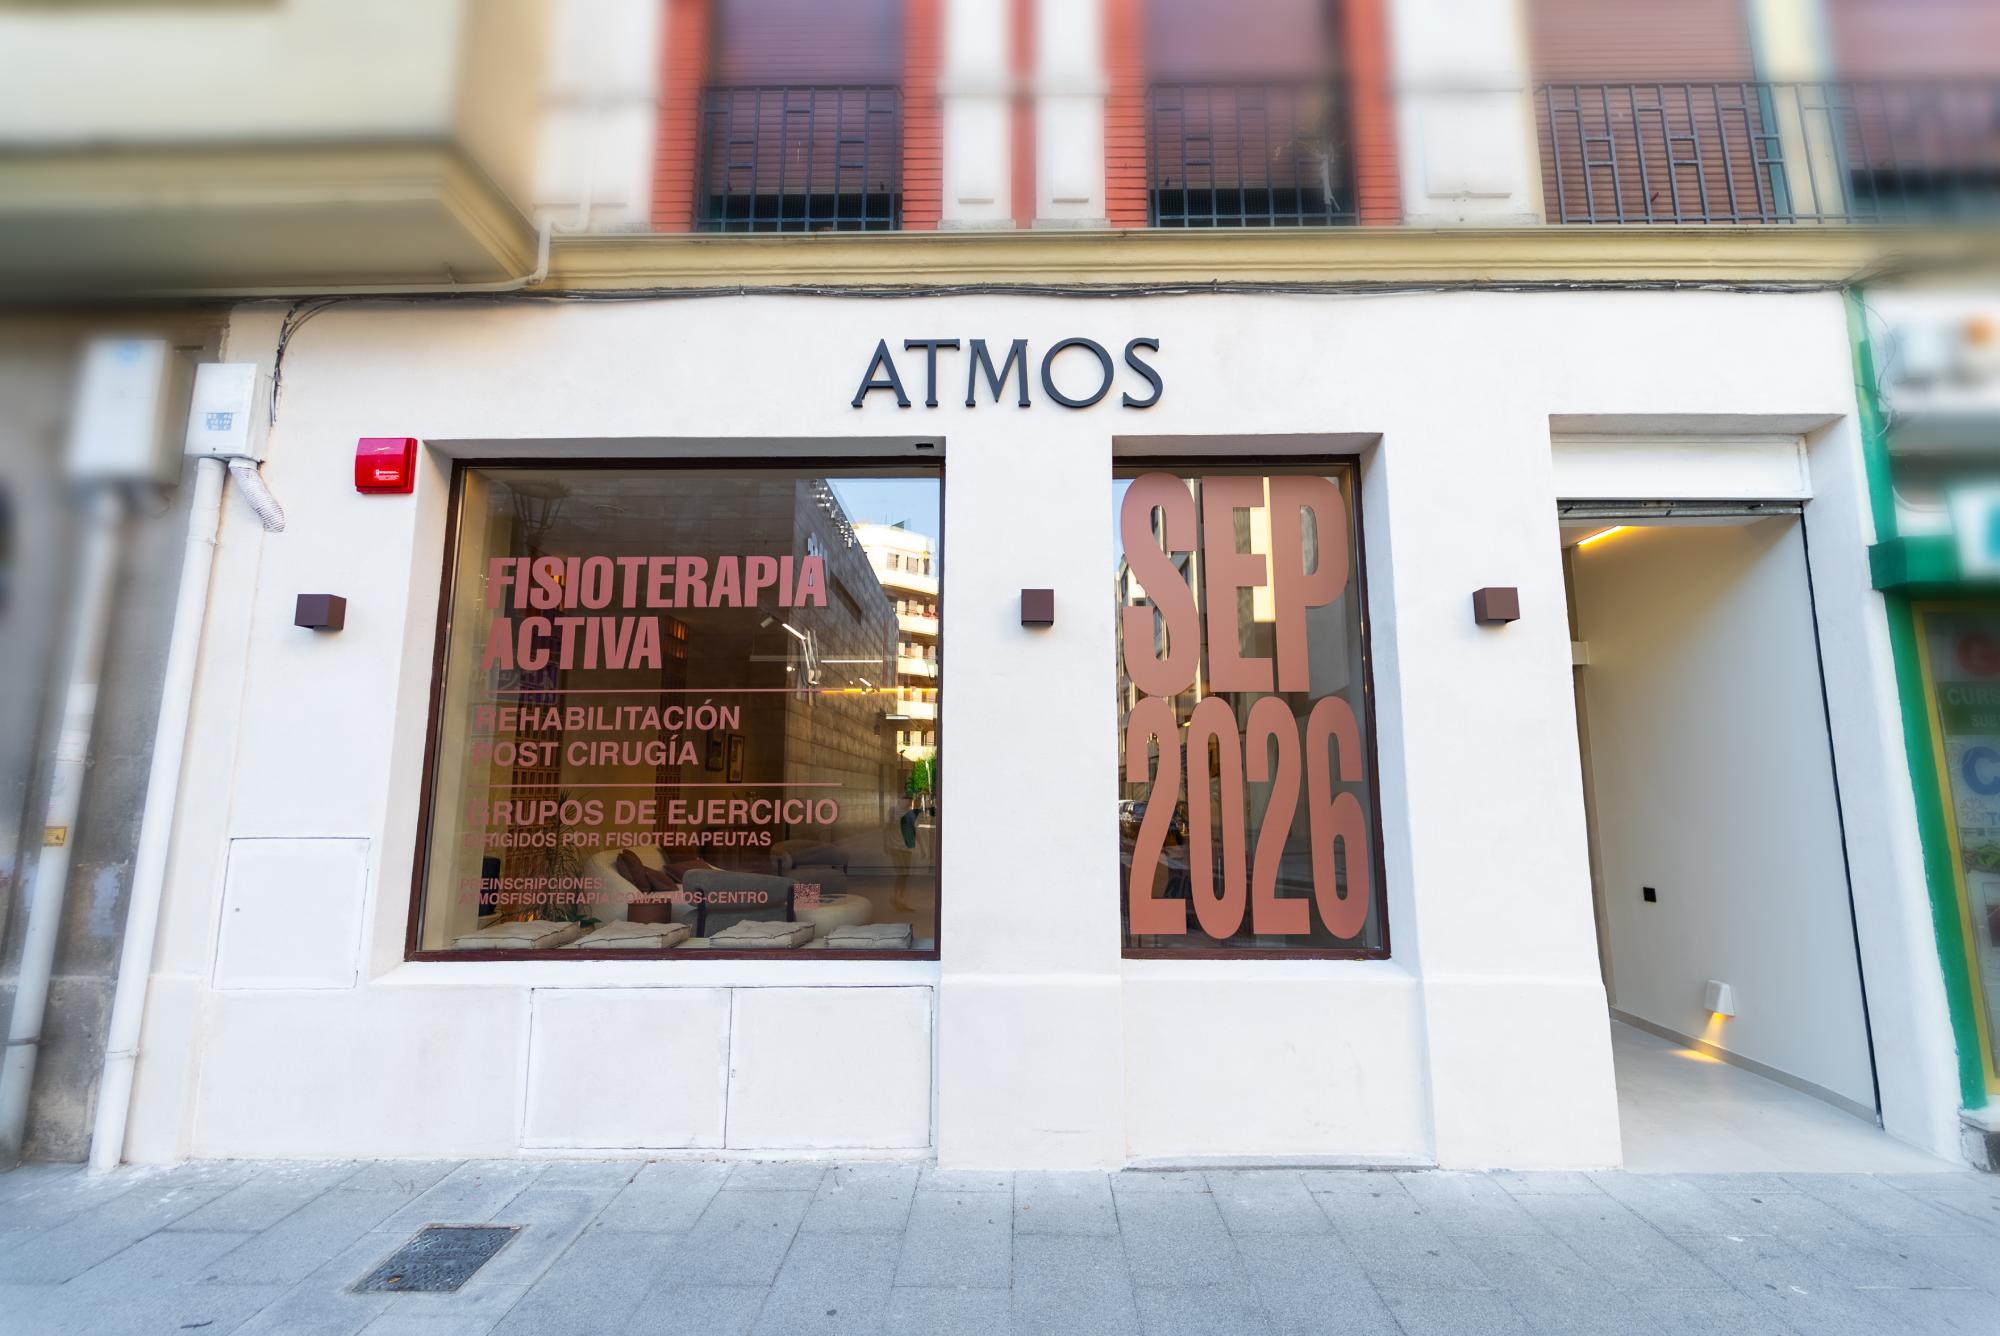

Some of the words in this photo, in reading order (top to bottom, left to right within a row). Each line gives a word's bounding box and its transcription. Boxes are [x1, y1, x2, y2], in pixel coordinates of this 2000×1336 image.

[851, 337, 1163, 408] ATMOS
[485, 555, 828, 610] FISIOTERAPIA
[1121, 472, 1349, 697] SEP
[480, 616, 663, 671] ACTIVA
[475, 699, 740, 732] REHABILITACIÓN
[471, 740, 558, 768] POST
[567, 735, 699, 767] CIRUGÍA
[466, 799, 604, 826] GRUPOS
[614, 799, 656, 825] DE
[668, 798, 839, 825] EJERCICIO
[1126, 696, 1370, 939] 2026
[463, 832, 557, 848] RIGIDOS
[562, 831, 599, 847] POR
[605, 831, 772, 847] FISIOTERAPEUTAS
[459, 891, 769, 905] ATMOSFISIOTERAPIACOM/ATMOS-CENTRO
